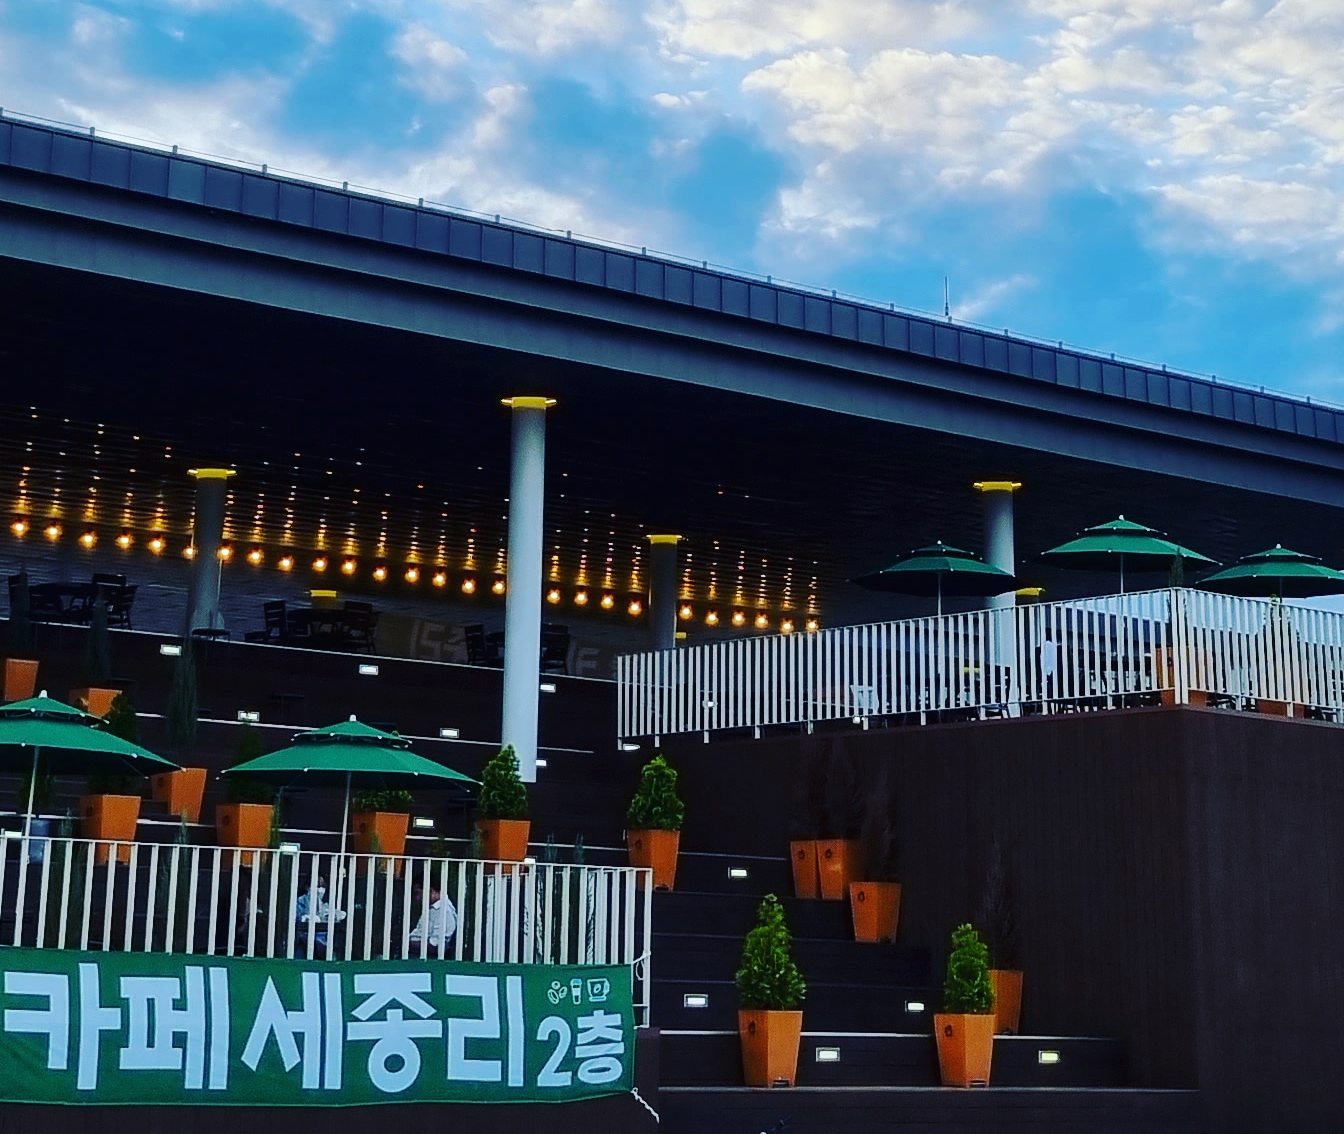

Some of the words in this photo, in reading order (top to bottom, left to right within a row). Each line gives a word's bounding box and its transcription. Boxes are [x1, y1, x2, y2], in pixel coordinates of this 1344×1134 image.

[3, 961, 230, 1091] 카페
[240, 971, 524, 1094] 세종리
[536, 1008, 626, 1087] 2층
